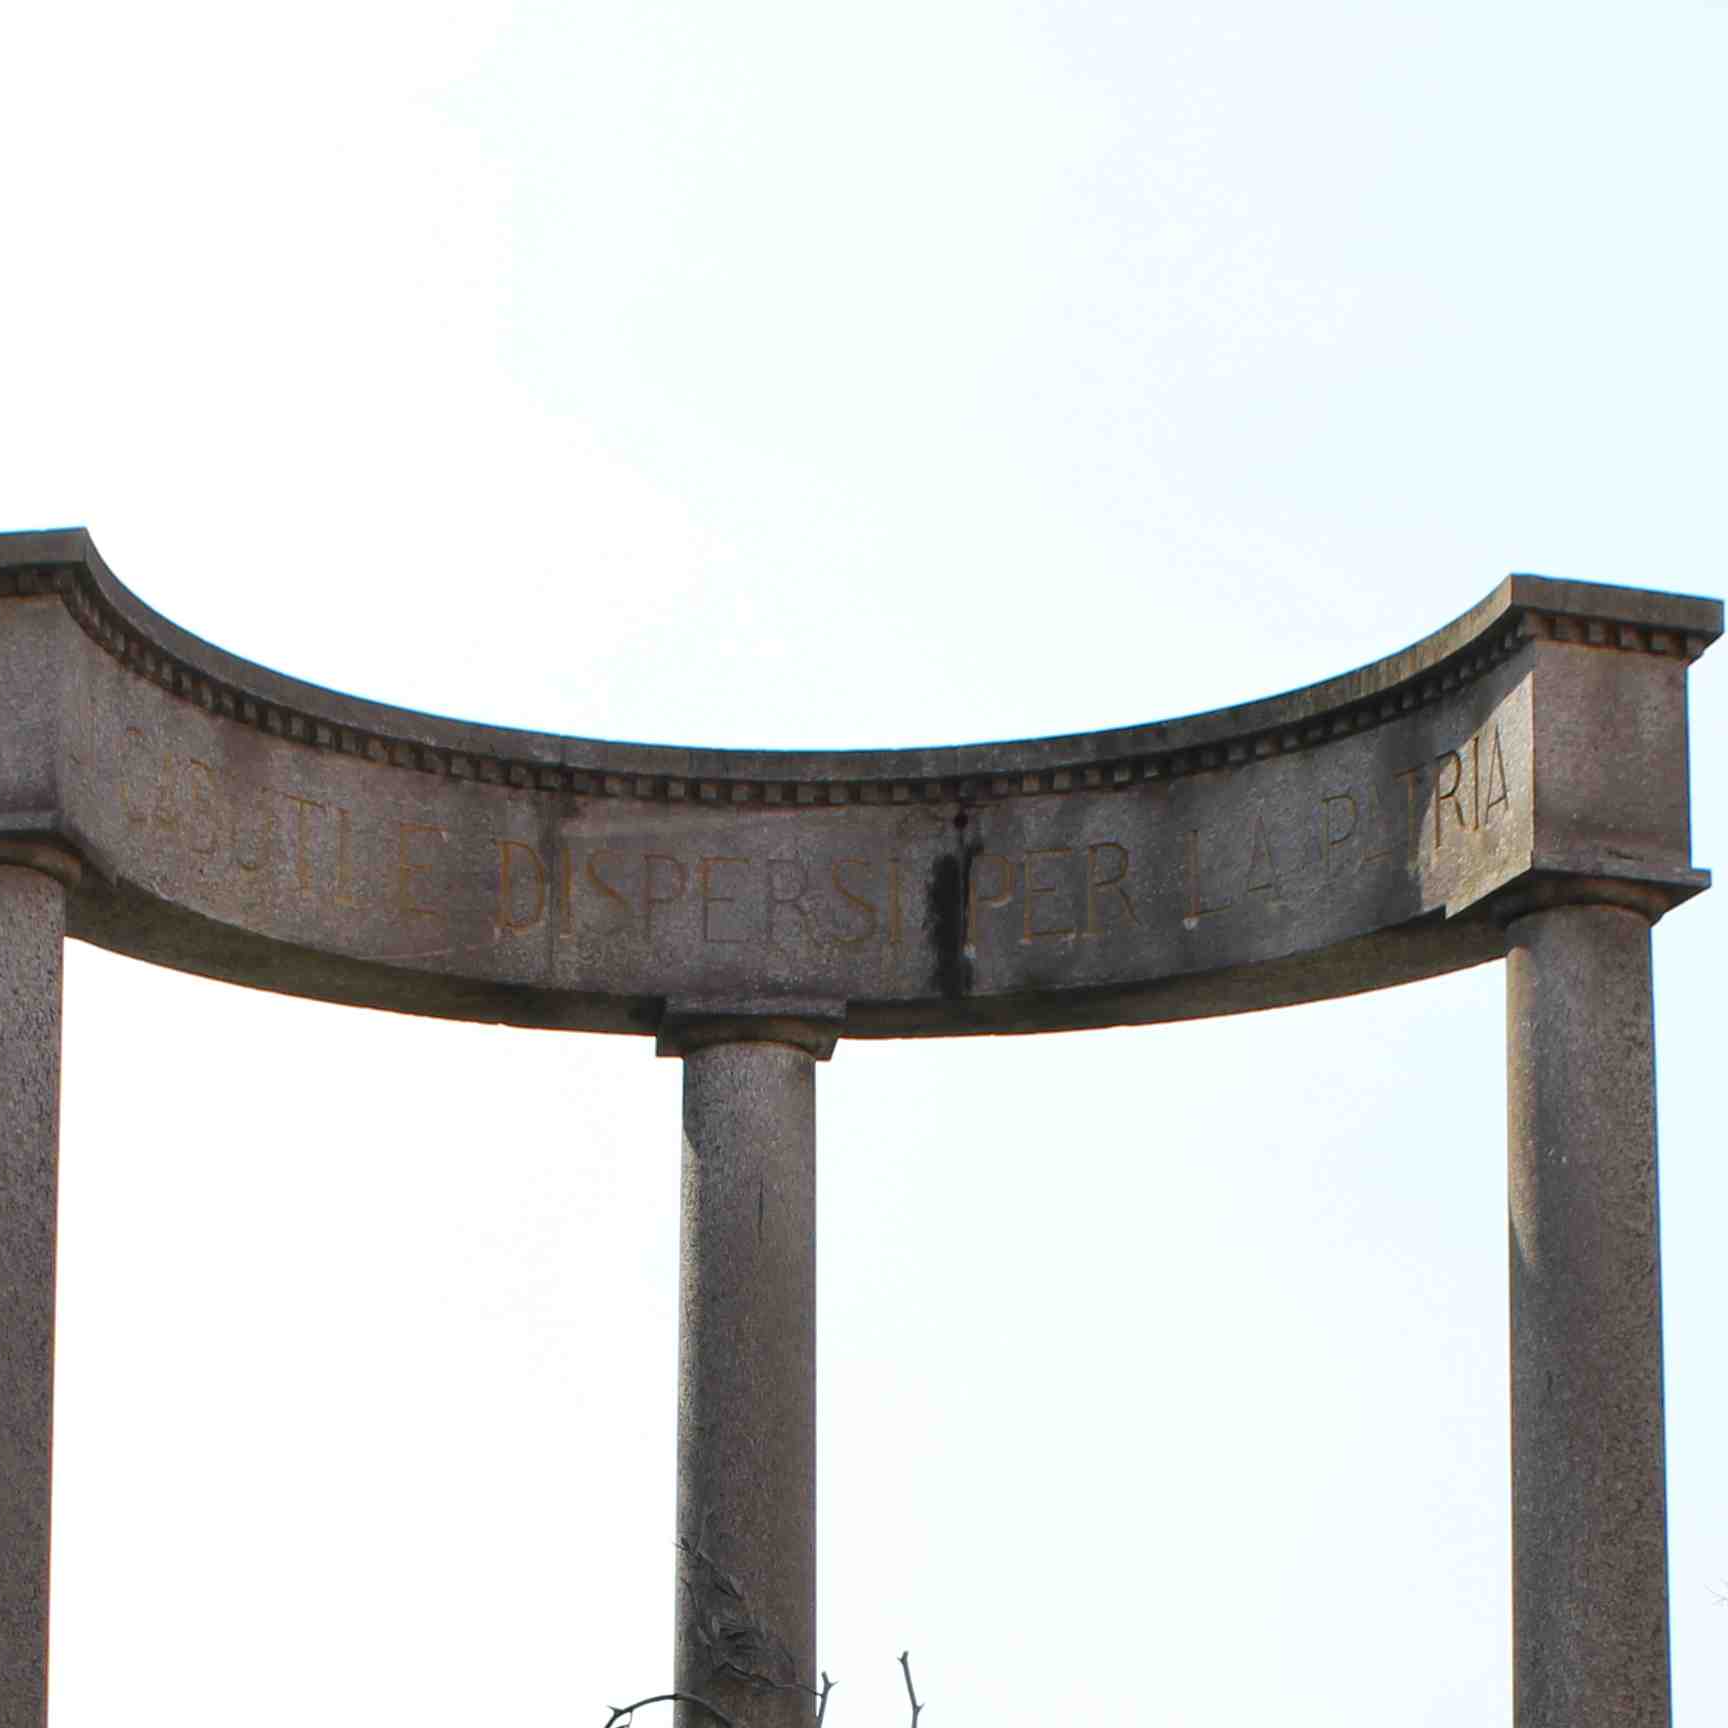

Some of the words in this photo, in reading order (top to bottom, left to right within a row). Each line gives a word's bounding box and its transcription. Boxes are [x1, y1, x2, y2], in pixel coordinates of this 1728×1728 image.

[120, 725, 354, 905] CADUTI
[399, 823, 449, 919] E
[495, 840, 904, 946] DISPERSI
[965, 841, 1140, 950] PER
[1183, 816, 1281, 919] LA
[1319, 724, 1509, 866] PATRIA
